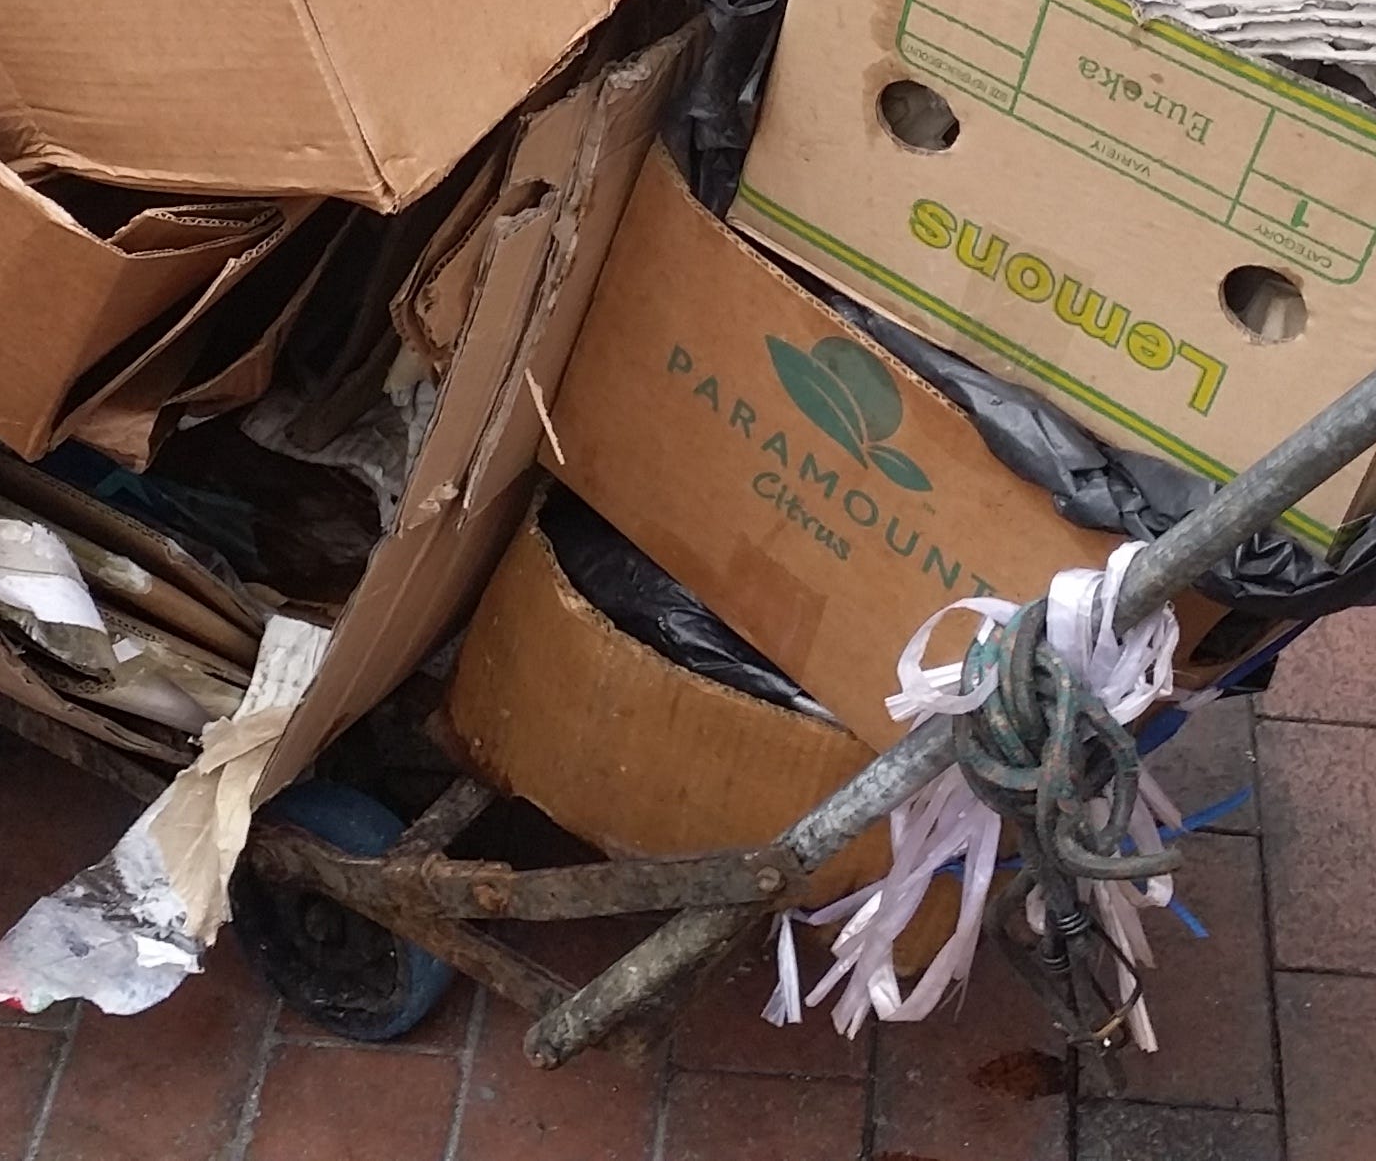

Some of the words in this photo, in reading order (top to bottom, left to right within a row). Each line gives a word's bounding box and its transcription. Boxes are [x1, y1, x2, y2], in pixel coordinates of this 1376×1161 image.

[1077, 54, 1215, 145] Eureka
[1253, 223, 1334, 270] CATEGORY
[1290, 199, 1313, 230] 1
[908, 197, 1229, 416] Lemons
[751, 472, 851, 562] Citrus
